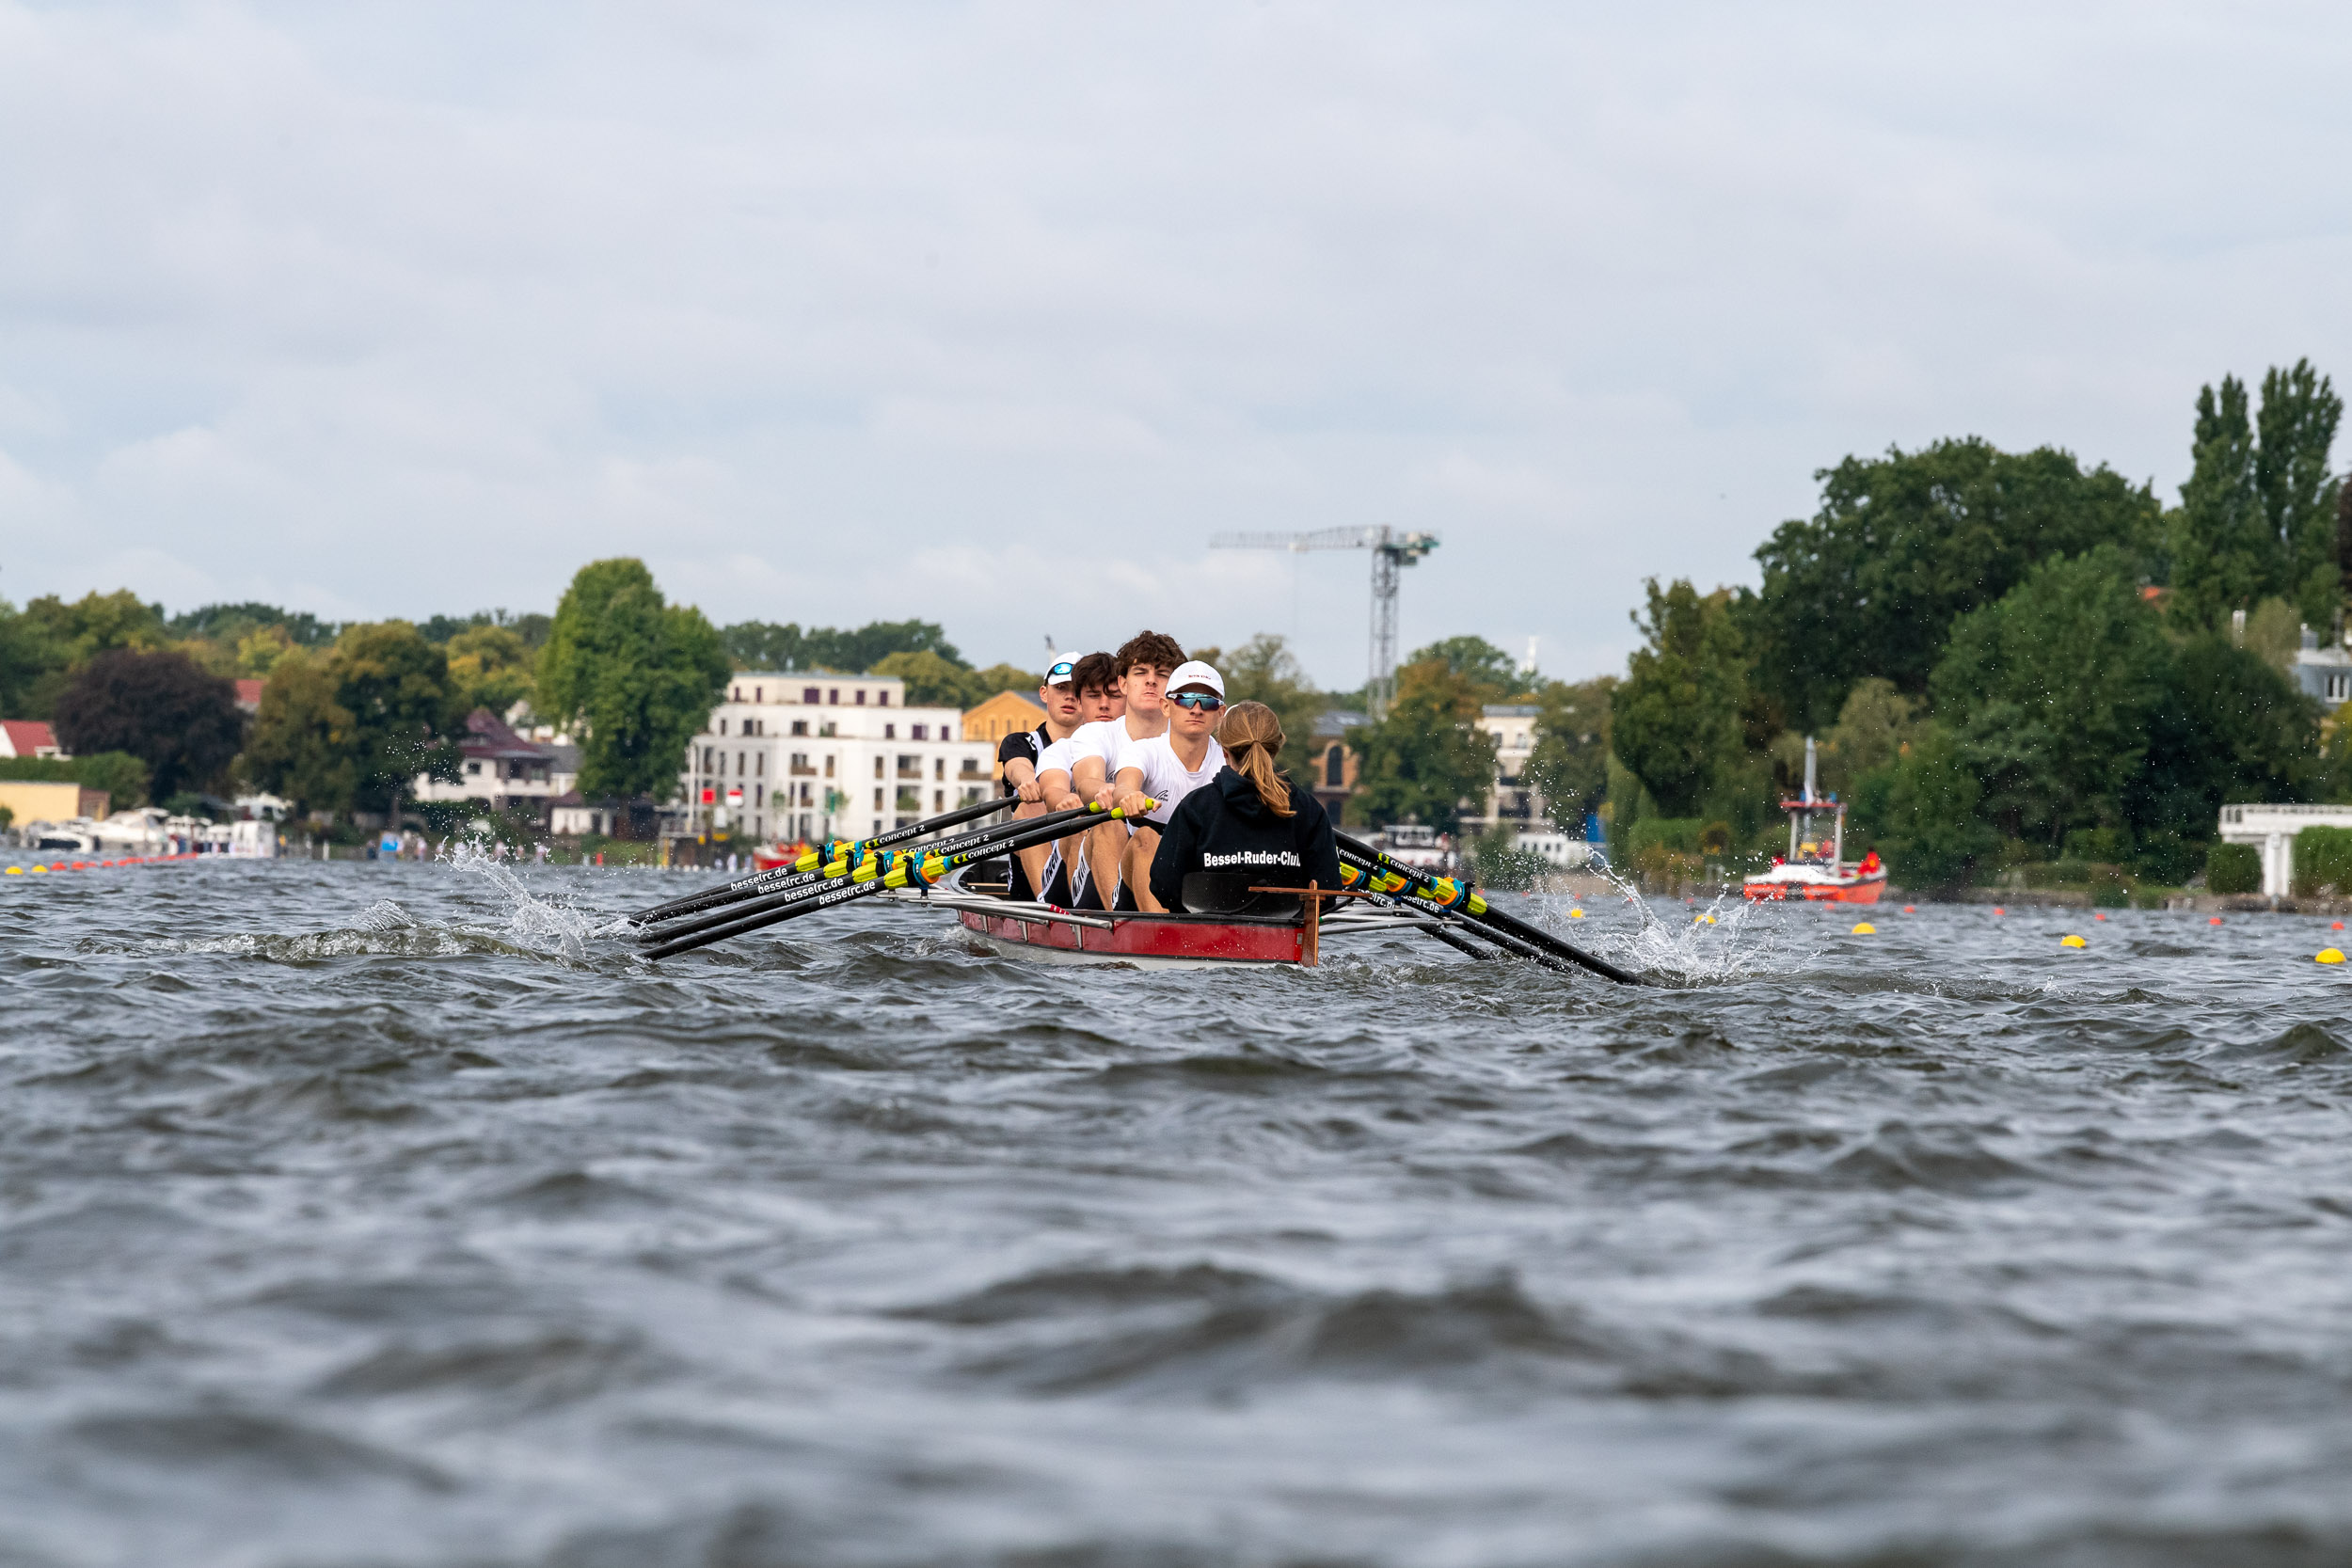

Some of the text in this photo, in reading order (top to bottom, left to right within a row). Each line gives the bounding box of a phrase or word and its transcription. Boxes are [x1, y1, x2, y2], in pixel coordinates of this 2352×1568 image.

[879, 824, 926, 845] concept 2
[940, 833, 990, 855] concept 2
[967, 839, 1015, 860] concept 2
[730, 866, 788, 892] besselrc.de
[1390, 859, 1430, 883] concept 2
[757, 872, 816, 895] besselrc.de
[784, 877, 844, 903] besselrc.de
[818, 879, 876, 906] besselrc.de
